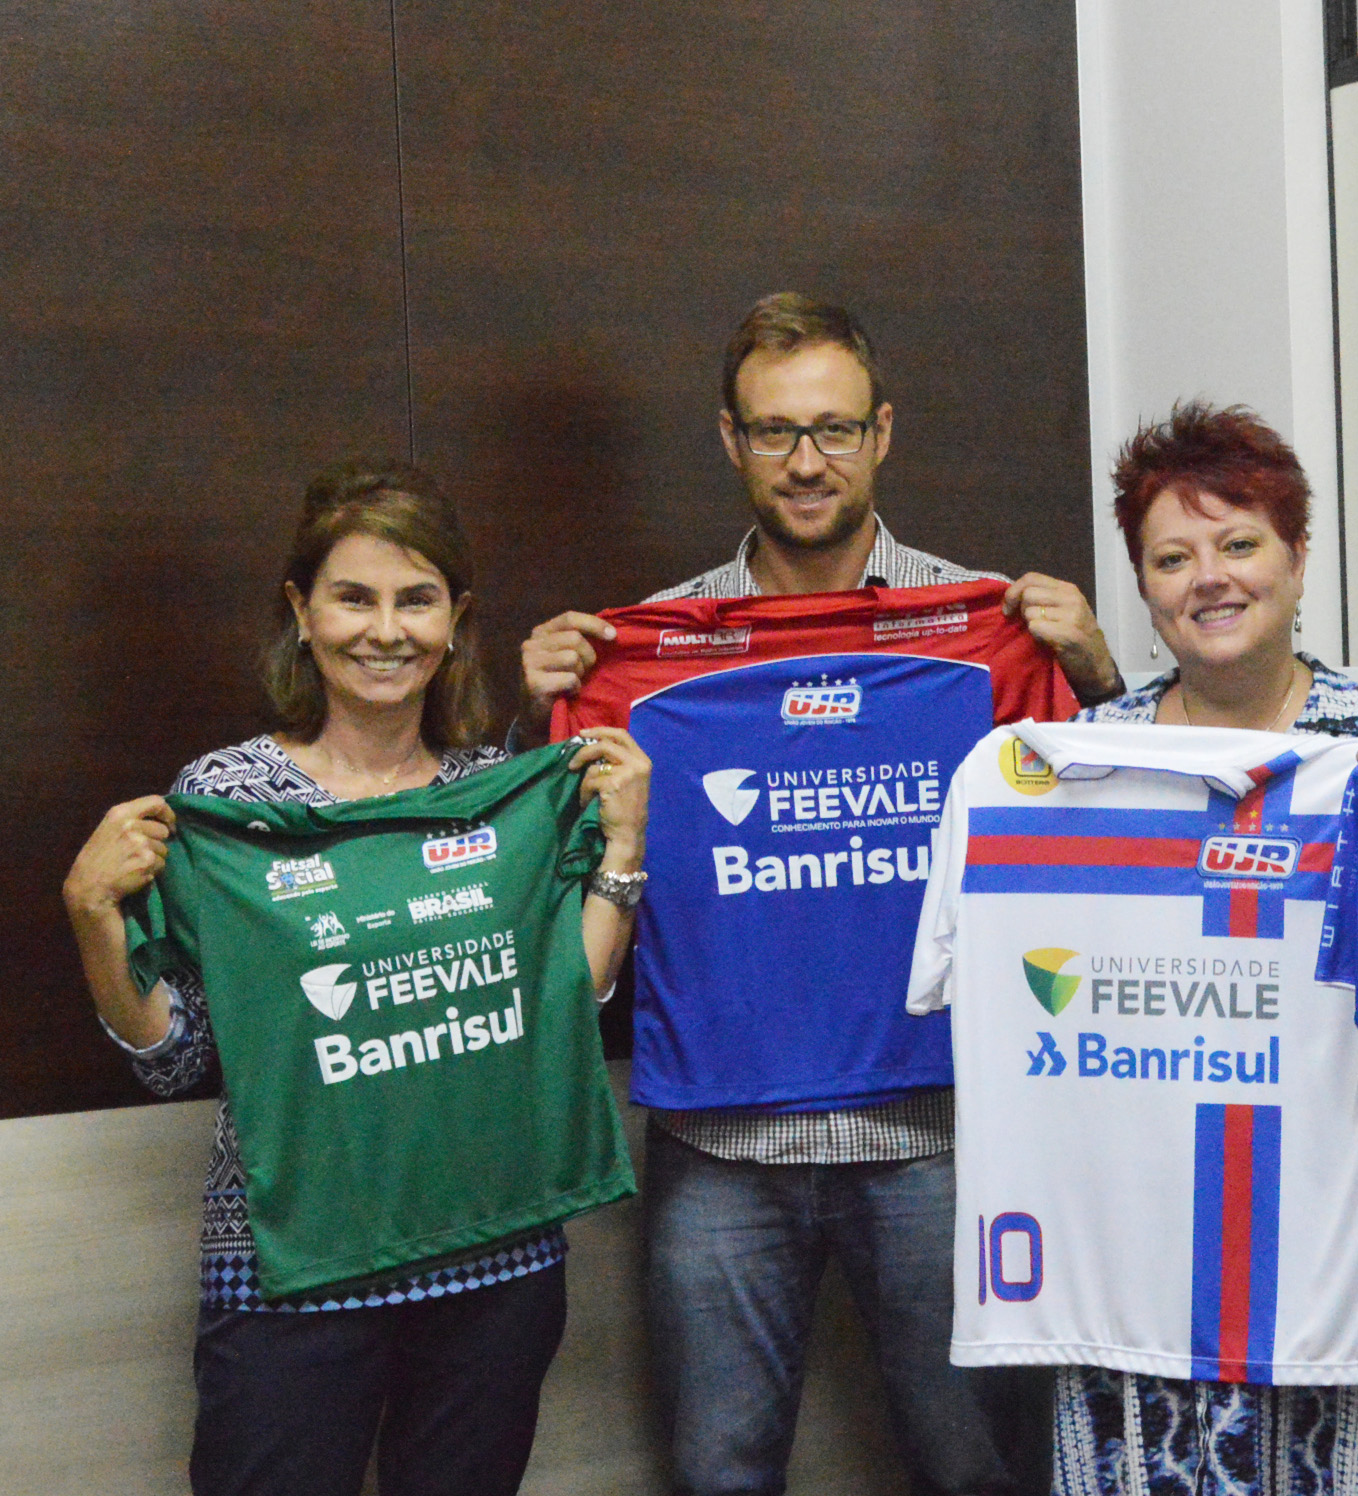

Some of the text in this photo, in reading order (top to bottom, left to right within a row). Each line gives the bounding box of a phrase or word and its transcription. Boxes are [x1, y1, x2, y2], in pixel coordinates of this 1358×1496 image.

[788, 692, 856, 716] UJR
[766, 760, 940, 788] UNIVERSIDADE
[768, 779, 941, 821] FEEVALE
[771, 814, 941, 834] CONHECIMENTO PARA INOVAR O MUNDO
[272, 853, 321, 874] Futsal
[426, 832, 493, 863] UJR
[1206, 841, 1291, 874] UJR
[408, 887, 494, 920] BRASIL
[362, 929, 516, 978] UNIVERSIDADE
[1090, 955, 1280, 979] UNIVERSIDADE
[366, 948, 519, 1011] FEEVALE
[1091, 979, 1280, 1021] FEEVALE
[313, 987, 525, 1085] Banrisul
[1077, 1031, 1280, 1085] Banrisul
[978, 1211, 1043, 1306] 10
